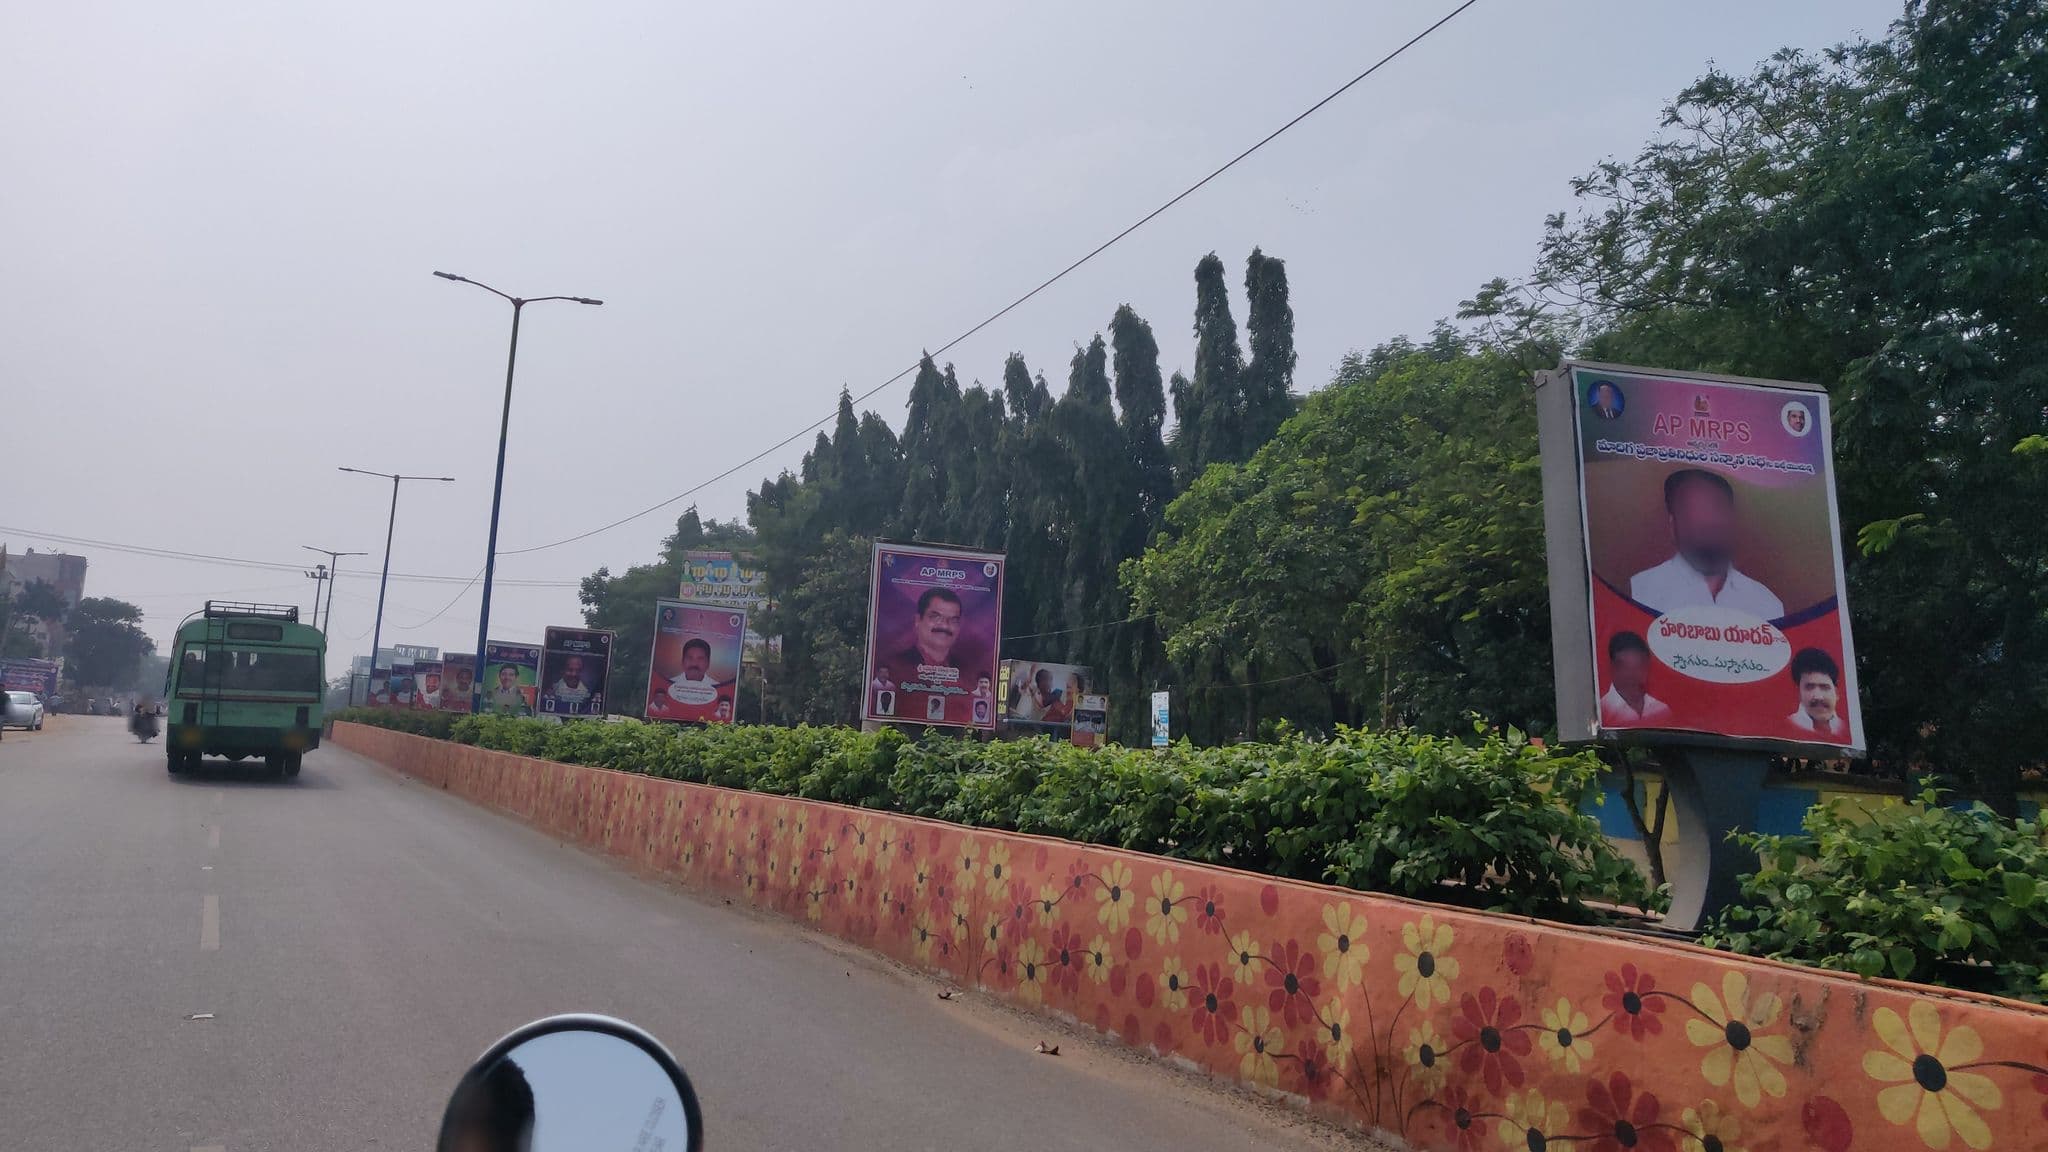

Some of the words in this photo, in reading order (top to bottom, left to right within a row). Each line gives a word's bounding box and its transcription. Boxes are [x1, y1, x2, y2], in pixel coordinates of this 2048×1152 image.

[1653, 413, 1682, 435] AP
[1689, 417, 1751, 442] MRPS
[920, 567, 936, 577] AP
[937, 569, 966, 580] MRPS
[1660, 618, 1721, 642] హరిబాబు
[1724, 623, 1773, 646] యాదవ్
